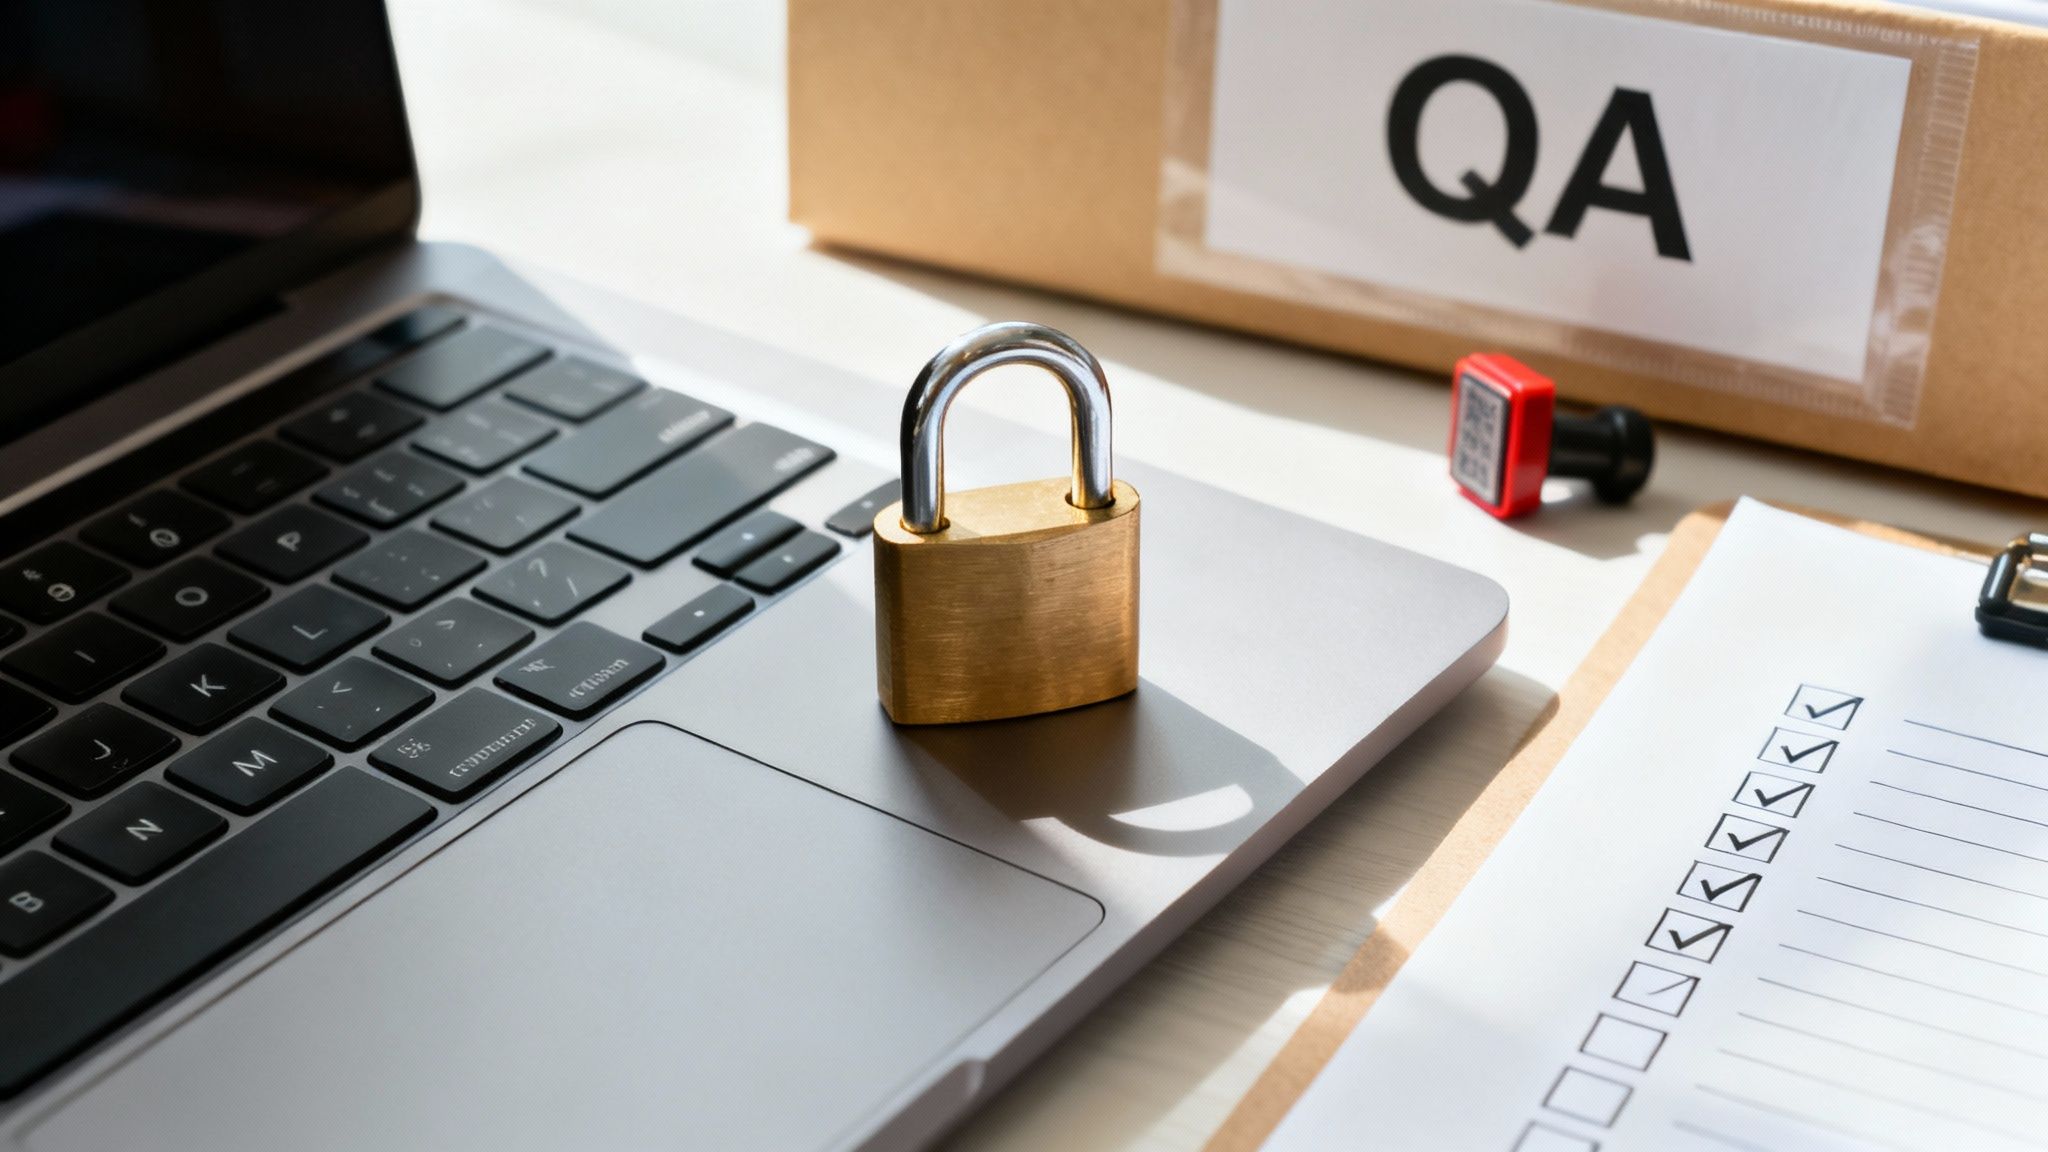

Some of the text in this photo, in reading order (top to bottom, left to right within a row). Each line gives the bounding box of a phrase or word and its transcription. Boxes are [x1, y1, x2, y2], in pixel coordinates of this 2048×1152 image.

[1386, 54, 1692, 263] QA
[190, 674, 227, 698] K
[232, 749, 278, 777] M
[125, 818, 164, 841] N
